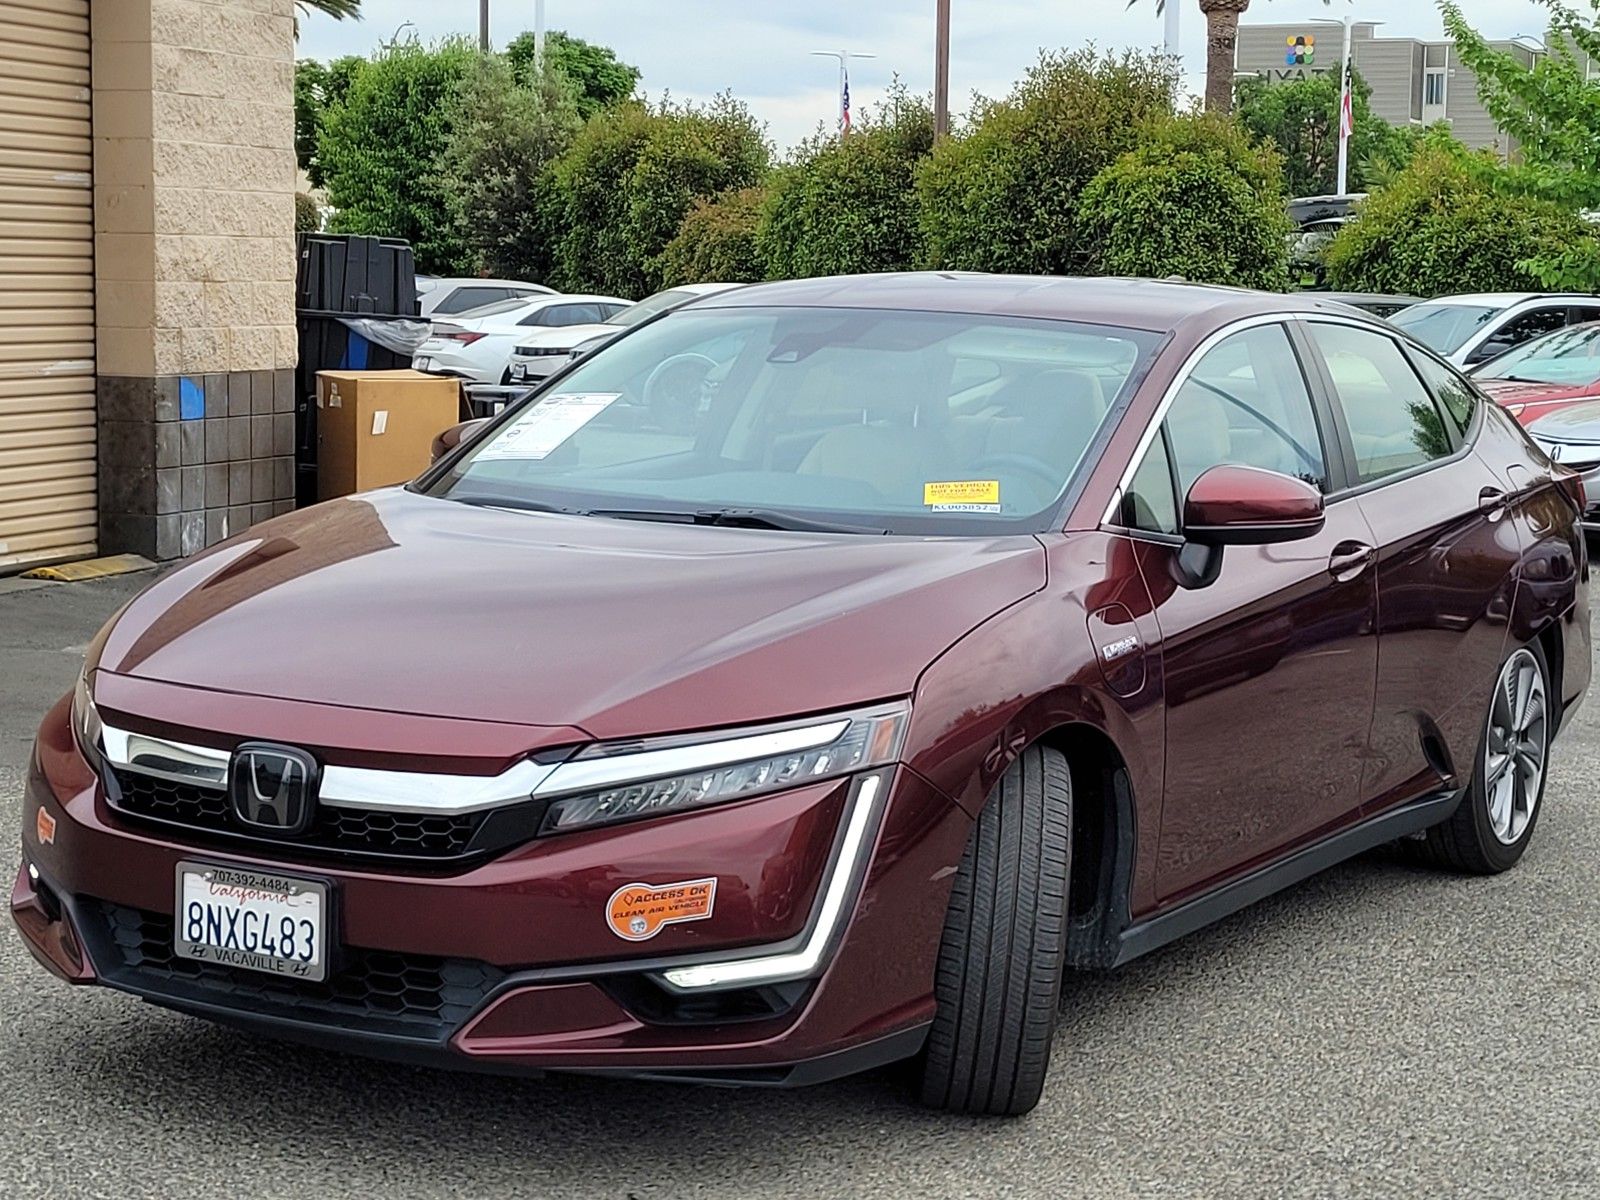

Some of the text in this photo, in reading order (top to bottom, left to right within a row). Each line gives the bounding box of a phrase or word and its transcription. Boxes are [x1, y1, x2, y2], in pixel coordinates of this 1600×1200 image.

[212, 869, 290, 892] 707-392-4484
[209, 881, 298, 907] California
[634, 885, 708, 904] ACCESS OK
[613, 900, 707, 919] CLEAN AIR VEHICLE
[187, 901, 315, 963] 8NXG483
[214, 948, 285, 972] VACAVILLE
